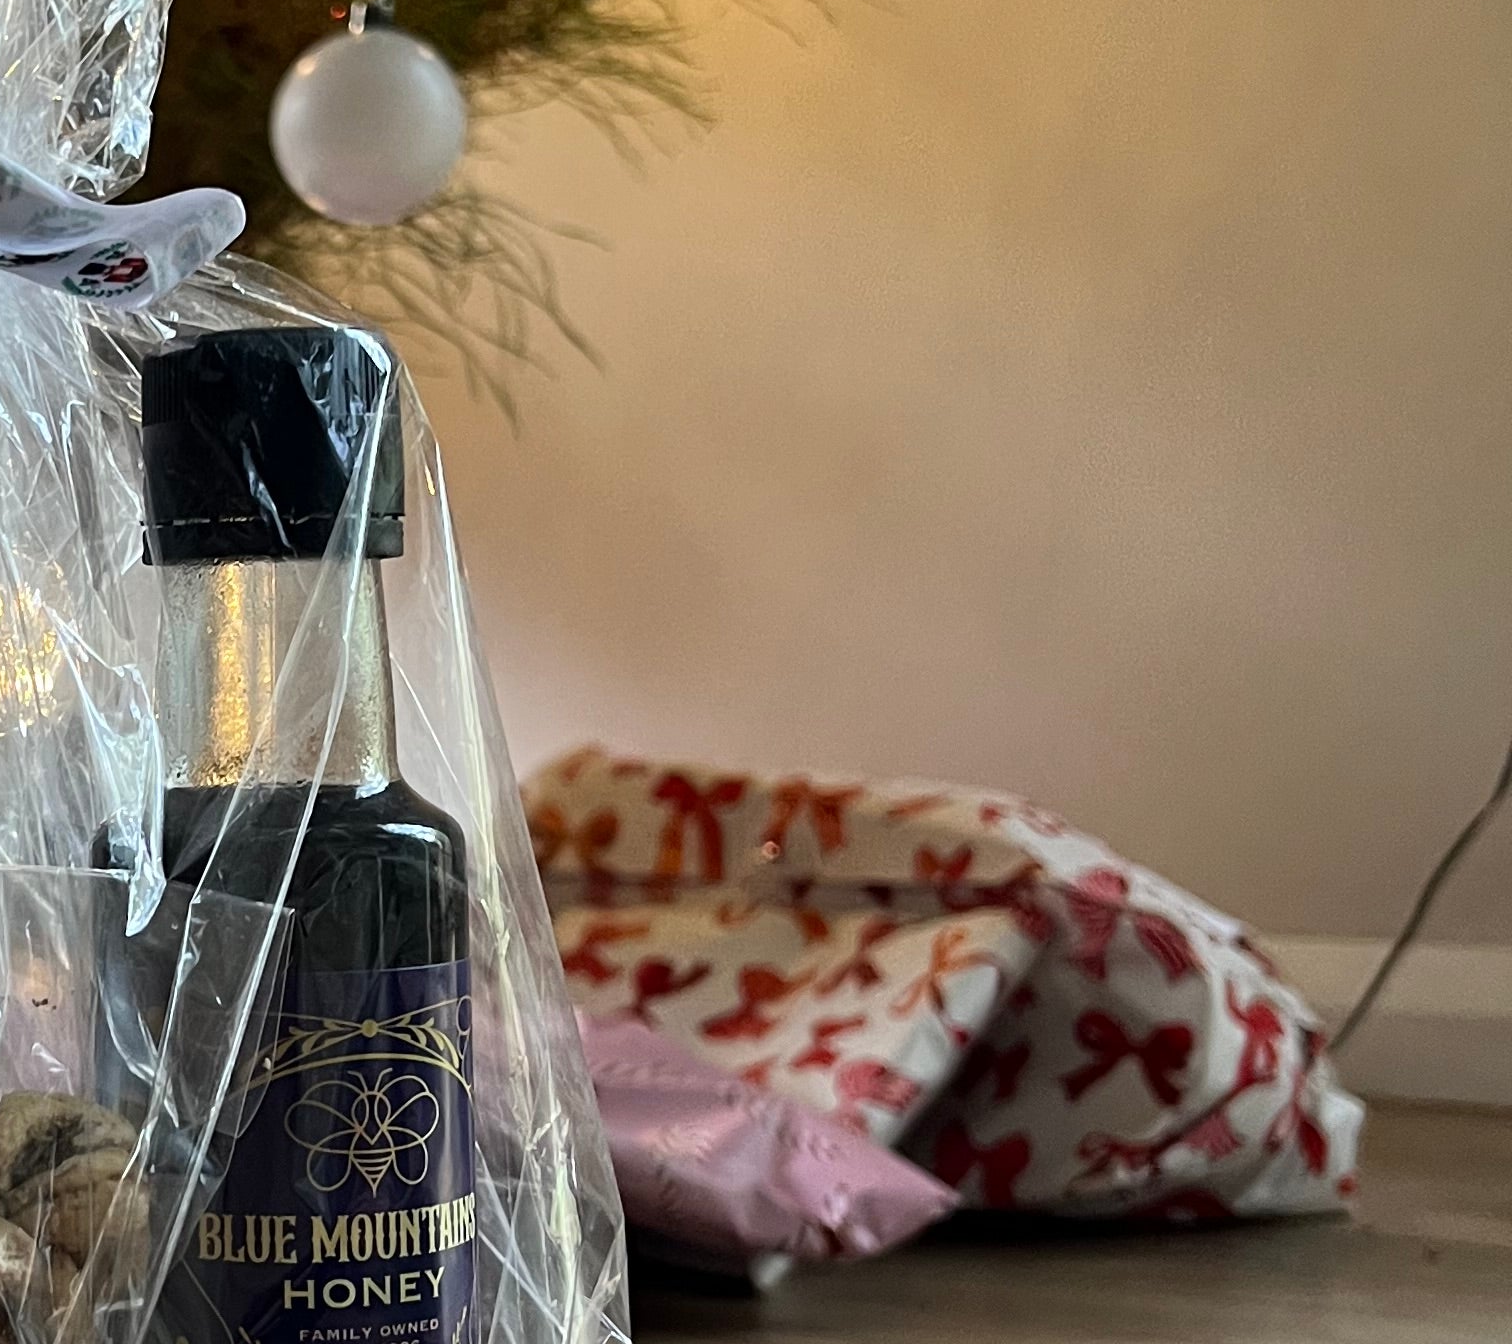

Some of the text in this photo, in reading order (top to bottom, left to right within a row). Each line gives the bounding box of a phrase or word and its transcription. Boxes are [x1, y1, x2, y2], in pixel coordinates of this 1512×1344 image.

[198, 1191, 476, 1265] BLUE MOUNTAINS
[283, 1266, 446, 1310] HONEY
[299, 1318, 440, 1342] FAMILY OWNED
